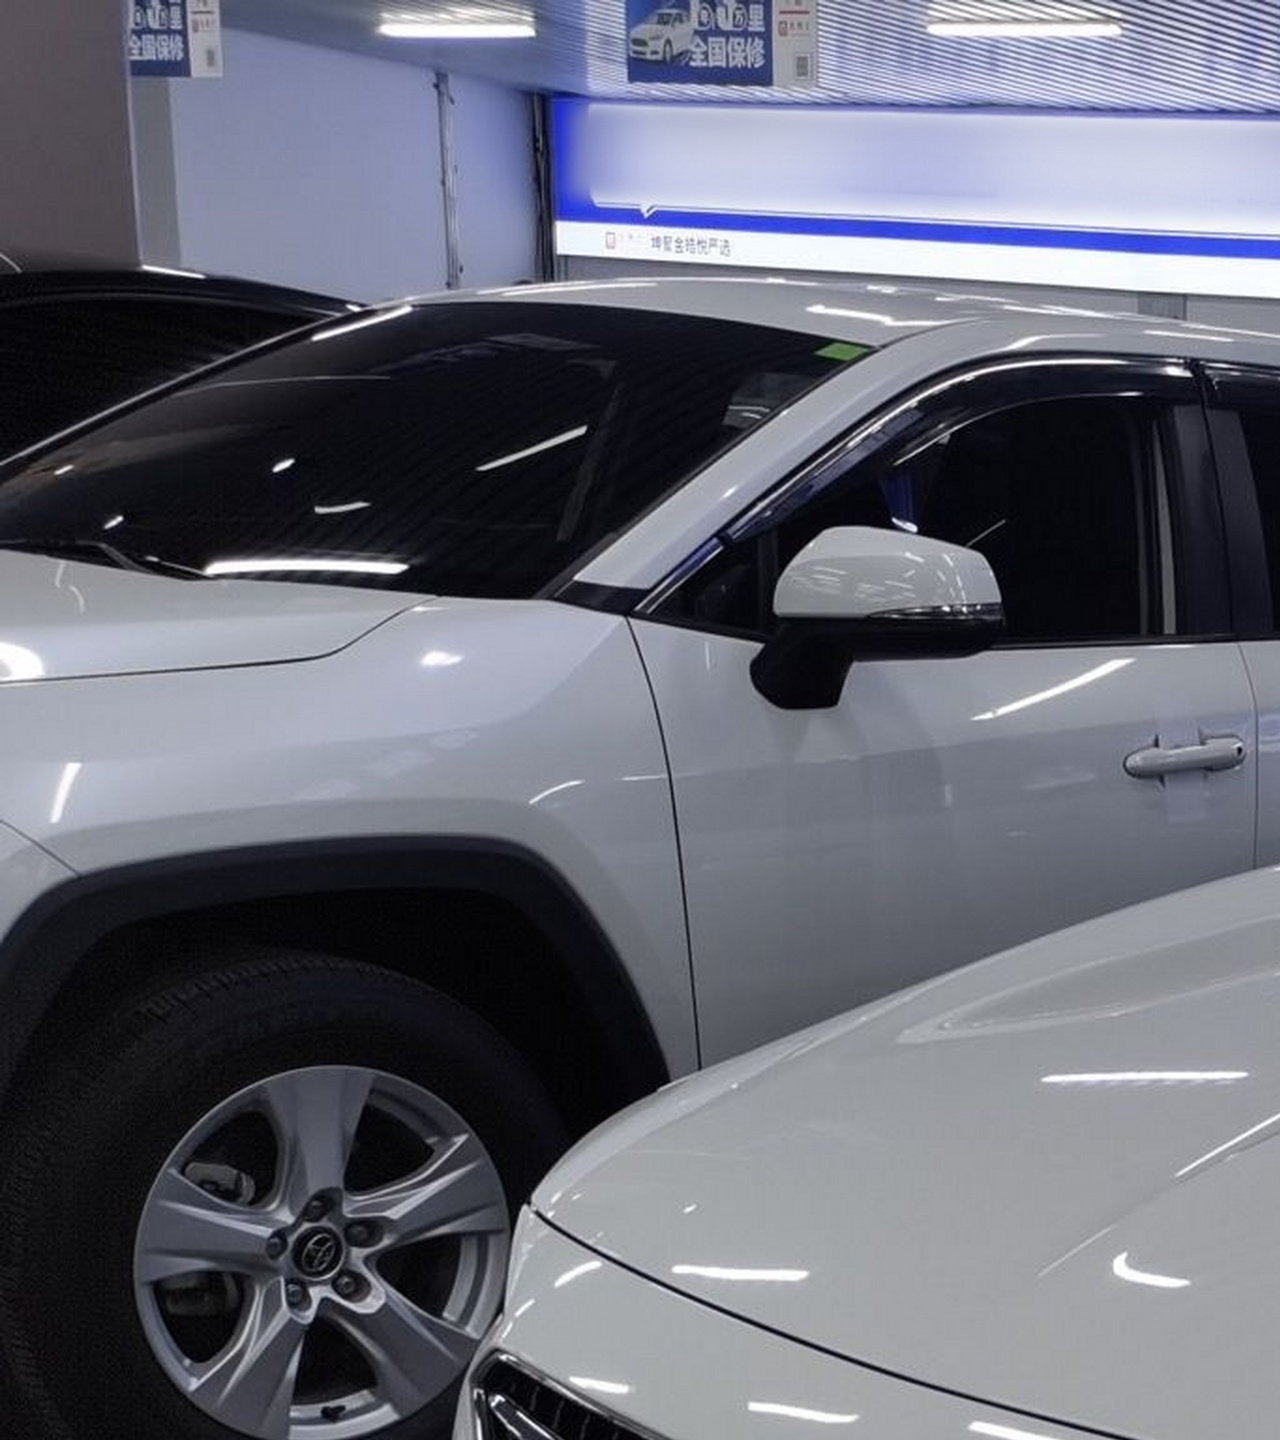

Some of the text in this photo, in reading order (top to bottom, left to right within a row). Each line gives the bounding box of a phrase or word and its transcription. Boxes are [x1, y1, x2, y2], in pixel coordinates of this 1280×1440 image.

[129, 34, 184, 61] 全国保修
[689, 37, 766, 68] 全国保修
